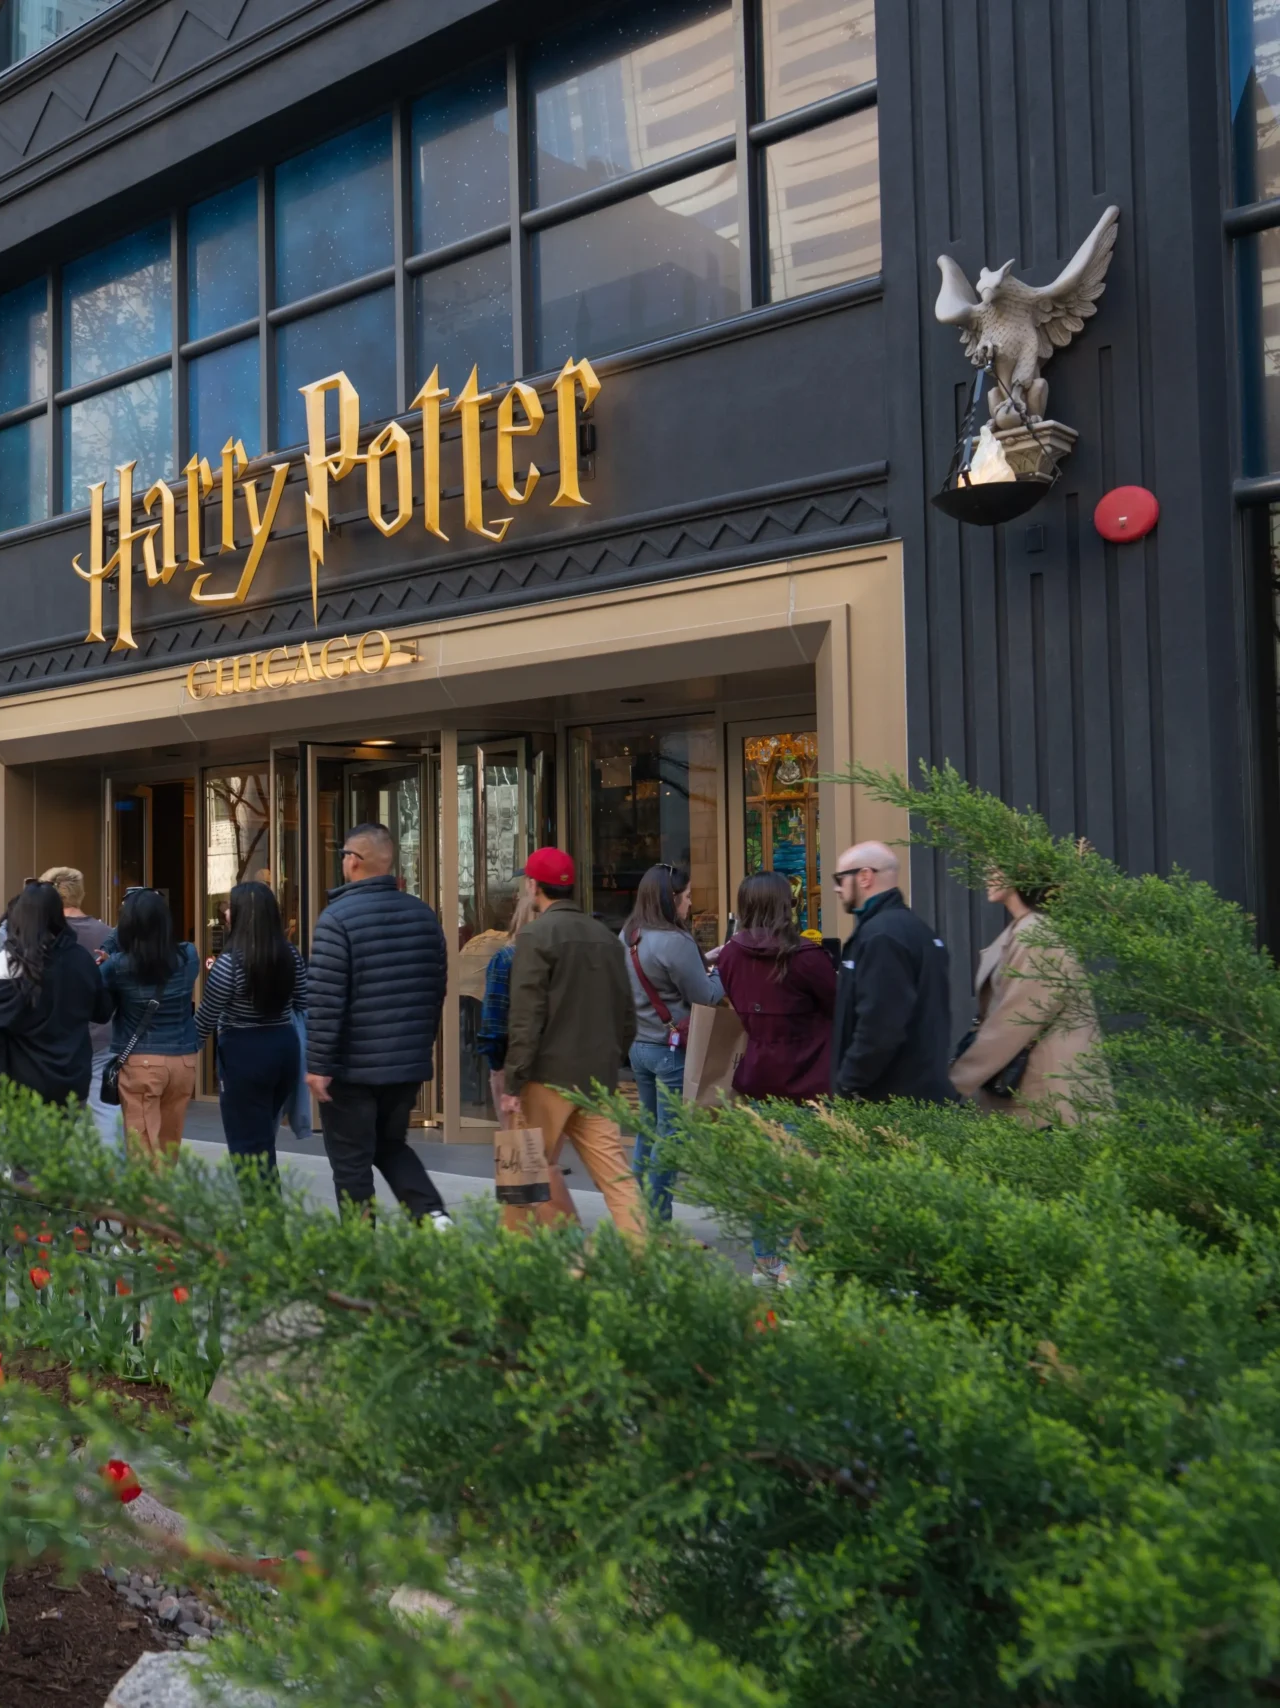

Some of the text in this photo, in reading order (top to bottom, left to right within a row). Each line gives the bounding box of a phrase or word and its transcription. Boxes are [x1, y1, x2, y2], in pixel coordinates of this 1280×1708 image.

[72, 356, 602, 650] Harry Potter
[187, 630, 391, 701] CHICAGO
